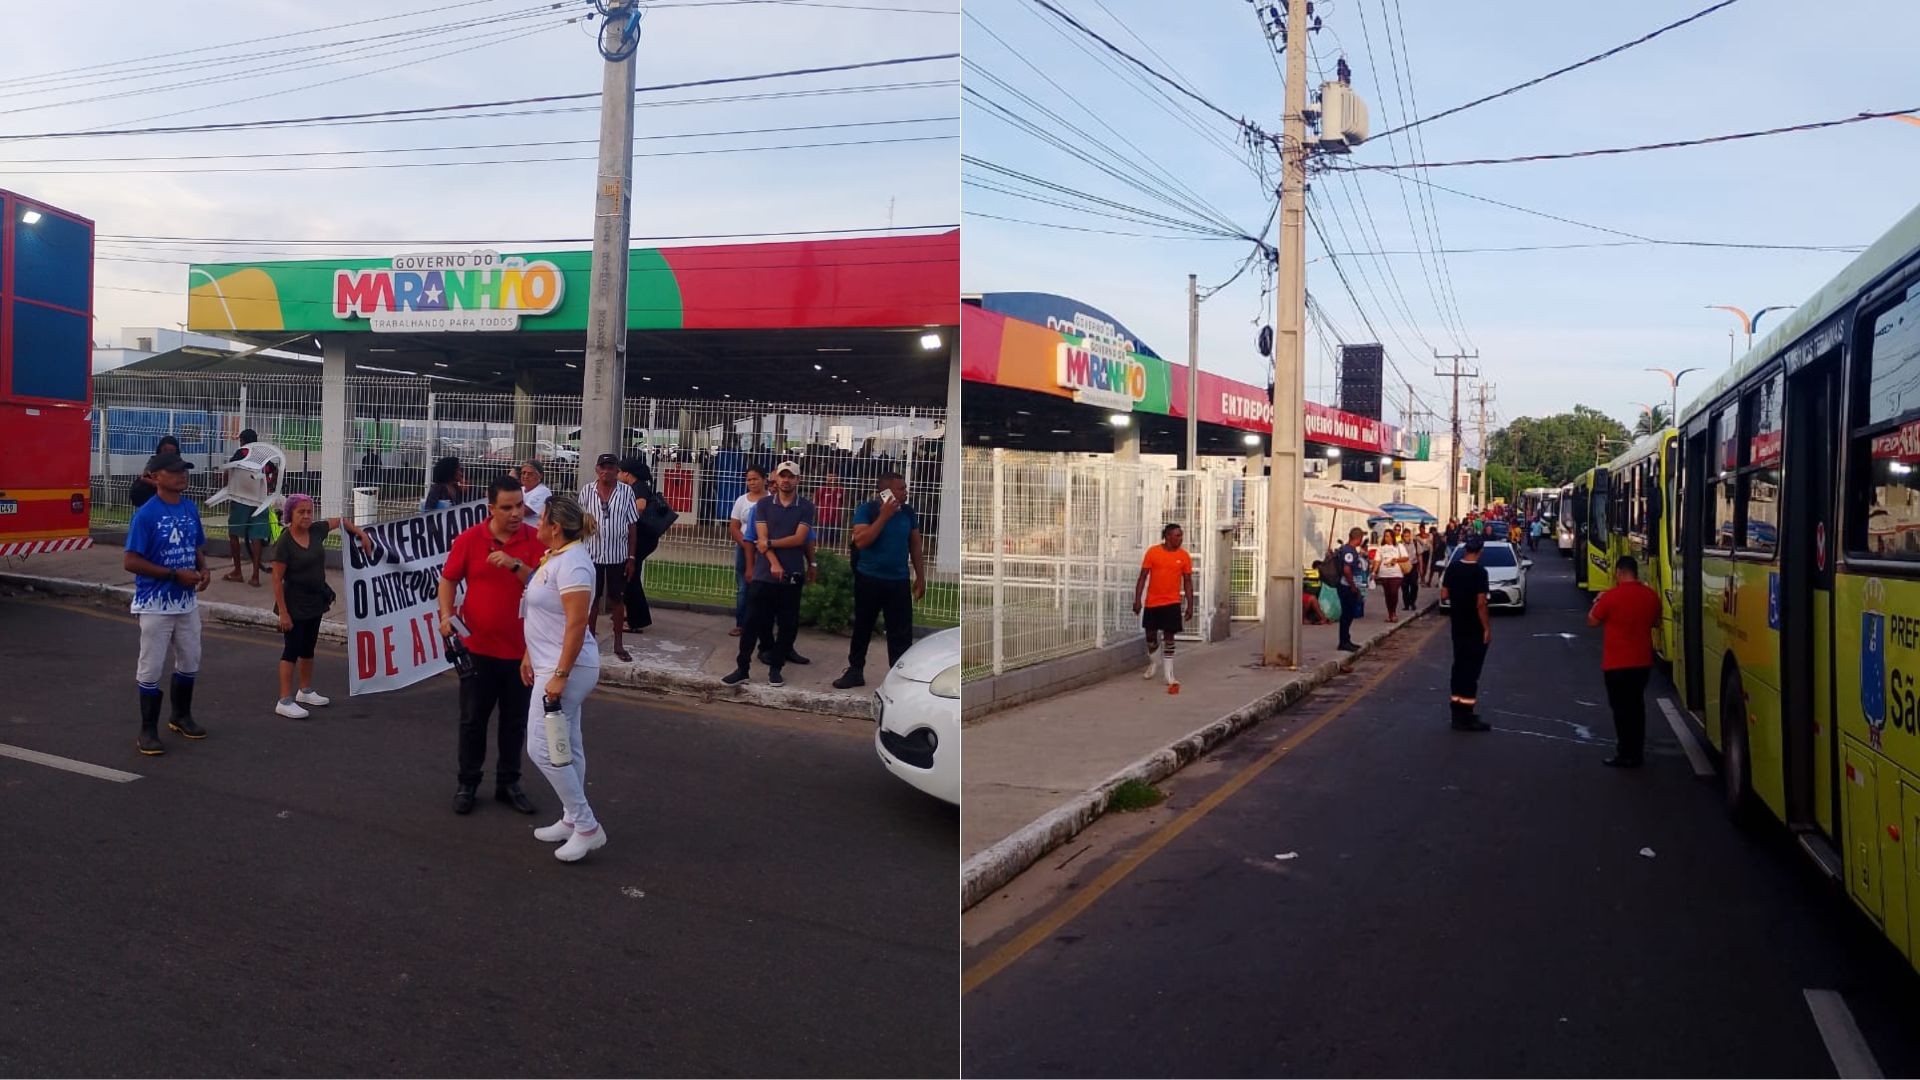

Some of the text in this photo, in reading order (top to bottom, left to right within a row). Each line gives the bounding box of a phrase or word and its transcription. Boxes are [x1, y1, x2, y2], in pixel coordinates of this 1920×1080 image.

[396, 254, 493, 270] GOVERNO DO
[337, 261, 556, 314] MARANHÃO
[374, 316, 514, 329] TRABALHANDO PARA TODOS
[1305, 414, 1333, 437] QUEIRO
[1333, 420, 1344, 438] DO
[350, 503, 491, 570] GOVERNADO
[353, 579, 367, 619] O
[356, 608, 449, 680] DE AT
[1890, 613, 1920, 650] PREF
[1890, 667, 1920, 737] Sã
